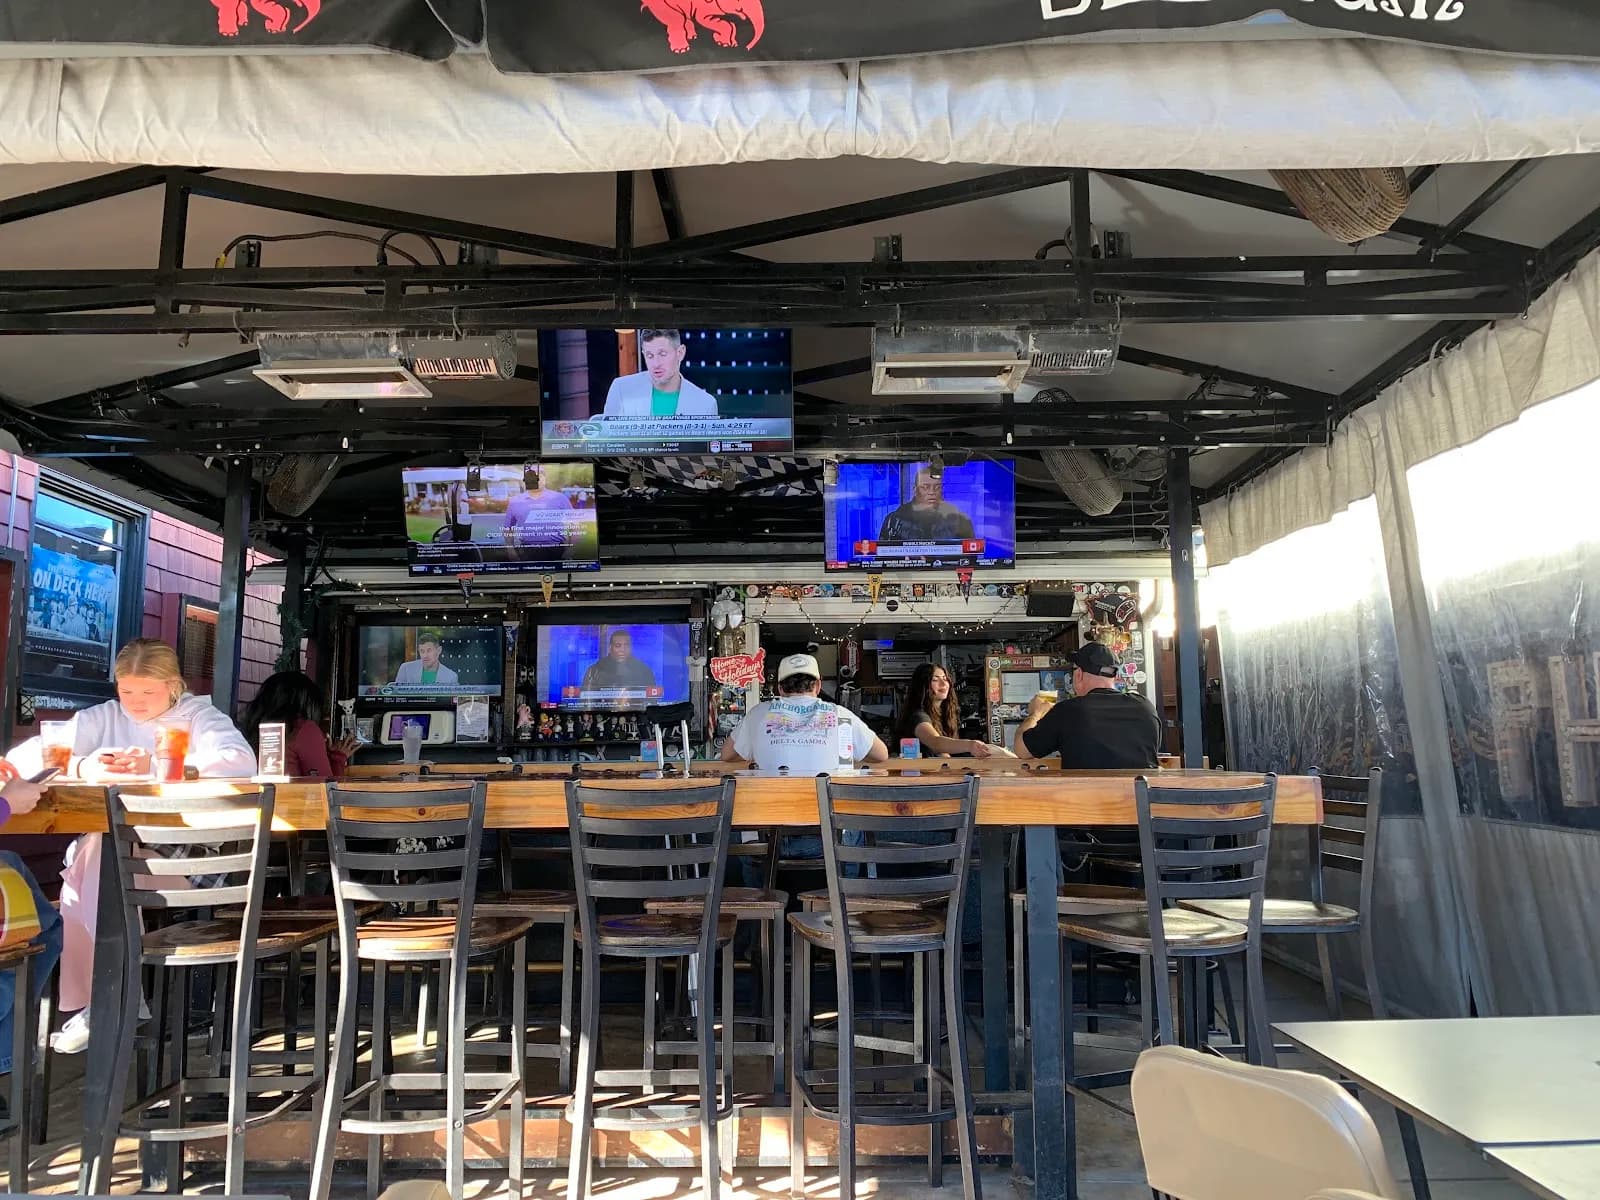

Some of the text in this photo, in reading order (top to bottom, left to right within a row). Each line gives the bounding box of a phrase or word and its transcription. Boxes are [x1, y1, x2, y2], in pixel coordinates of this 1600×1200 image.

[656, 423, 683, 431] Packers
[728, 421, 743, 429] 4:25
[744, 421, 753, 429] ET
[33, 569, 52, 589] ON
[53, 575, 83, 598] DECK
[770, 738, 827, 746] DELTA GAMMA
